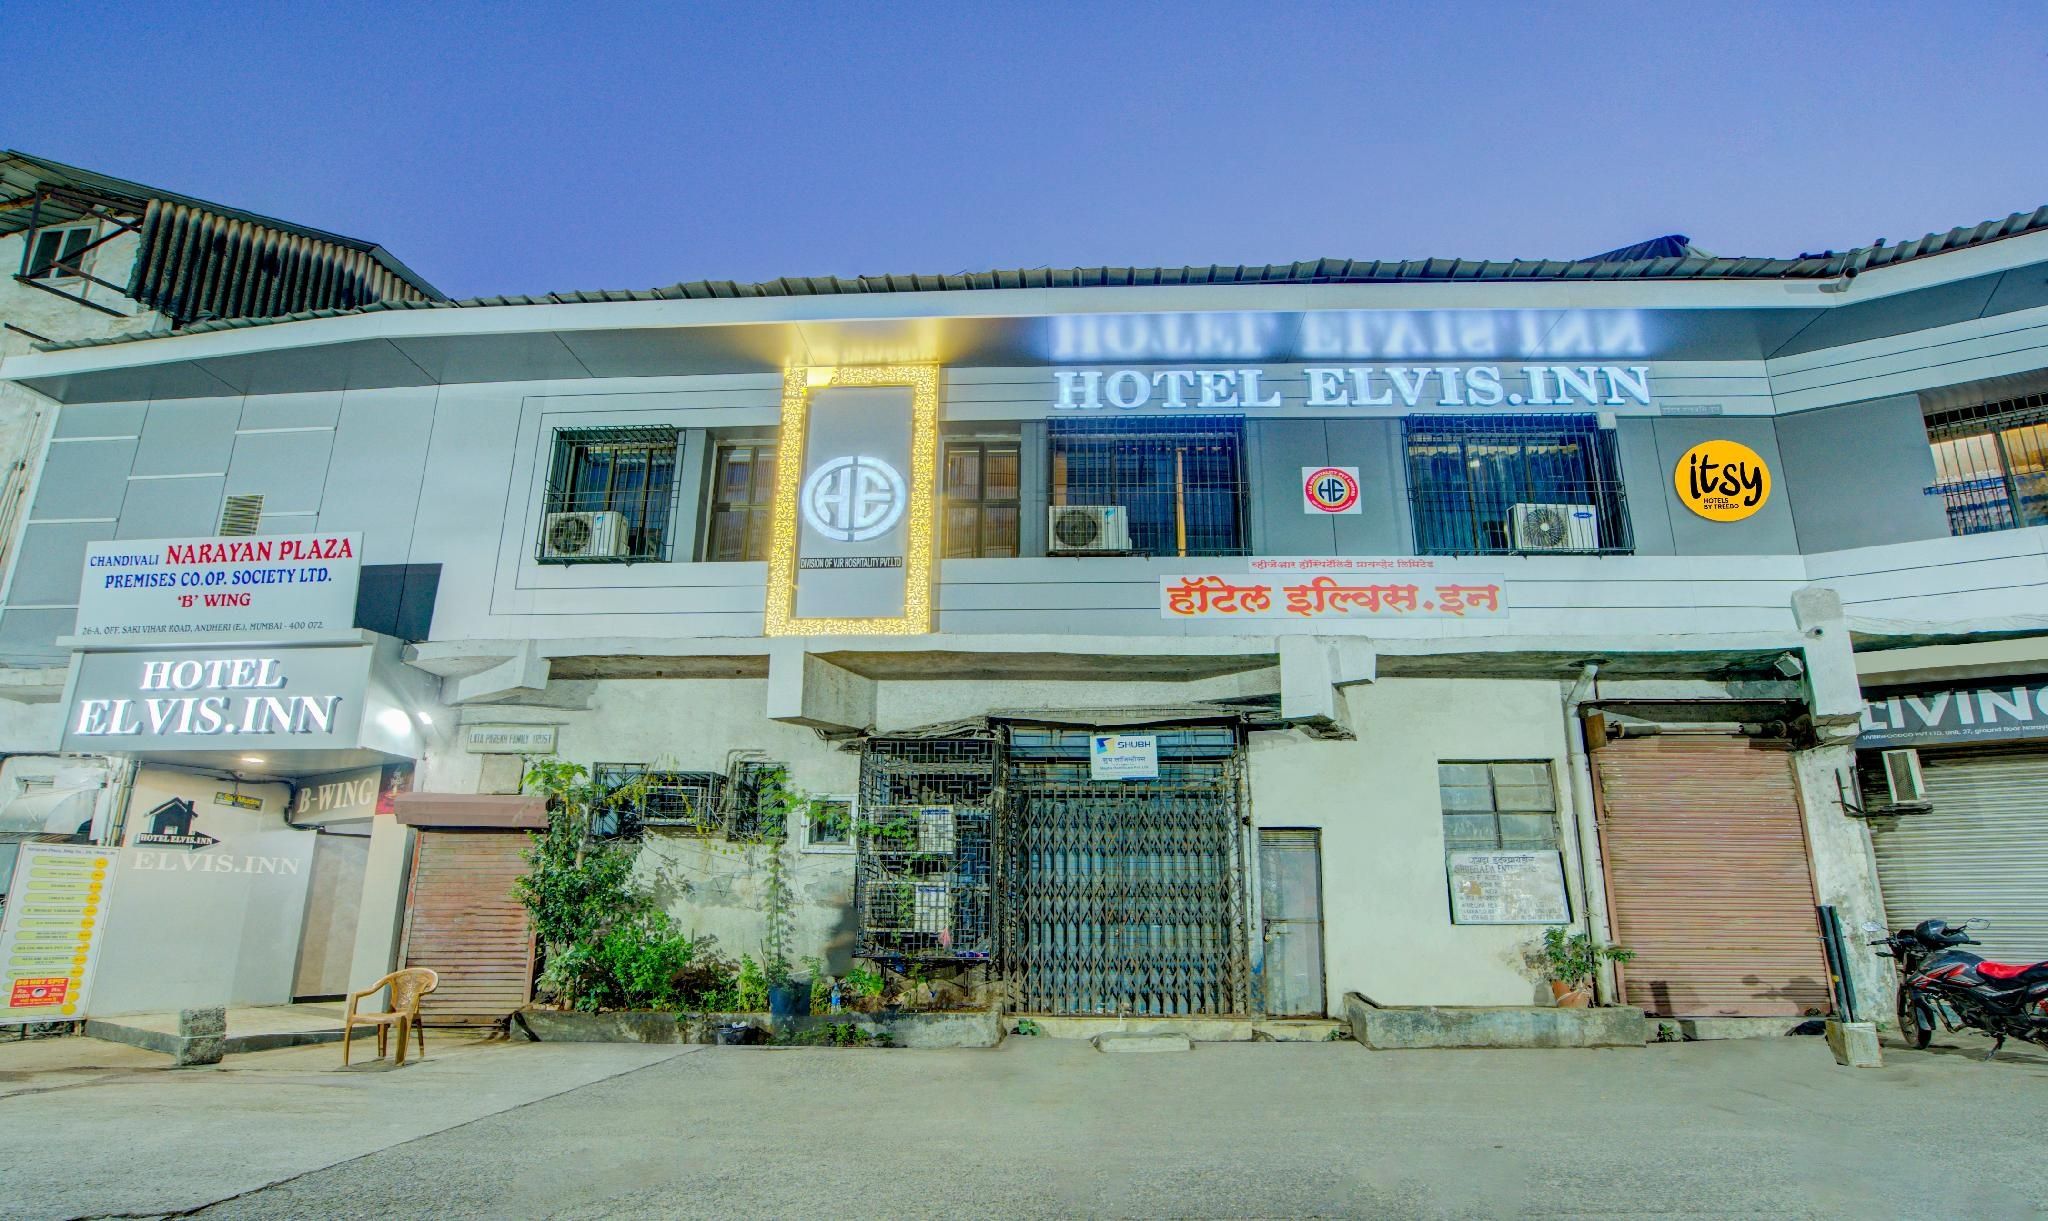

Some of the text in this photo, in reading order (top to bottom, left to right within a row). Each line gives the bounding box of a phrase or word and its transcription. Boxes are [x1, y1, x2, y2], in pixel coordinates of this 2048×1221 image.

[1054, 366, 1649, 409] HOTEL ELVIS.INN
[1690, 453, 1762, 506] itsy
[90, 538, 353, 567] CHANDIVALI NARAYAN PLAZA
[800, 558, 824, 569] DIVISION
[825, 558, 833, 568] OF
[834, 558, 844, 568] VJR
[845, 557, 880, 568] HOSPITALITY
[104, 567, 332, 589] PREMISES CO.OP. SOCIETY LTD.
[204, 593, 251, 607] WING
[1166, 576, 1272, 615] हॉटेल
[122, 625, 140, 634] SAKI
[142, 625, 167, 634] VIHAR
[168, 624, 193, 633] ROAD,
[194, 623, 232, 632] ANDHERI
[249, 622, 283, 631] MUMBAI
[289, 621, 306, 630] 400
[140, 658, 287, 690] HOTEL
[73, 695, 342, 736] ELVIS.INN
[1117, 741, 1151, 749] SHUBH
[297, 778, 375, 814] B-WING
[140, 833, 213, 846] HOTEL ELVIS.INN
[132, 851, 300, 876] ELVIS.INN
